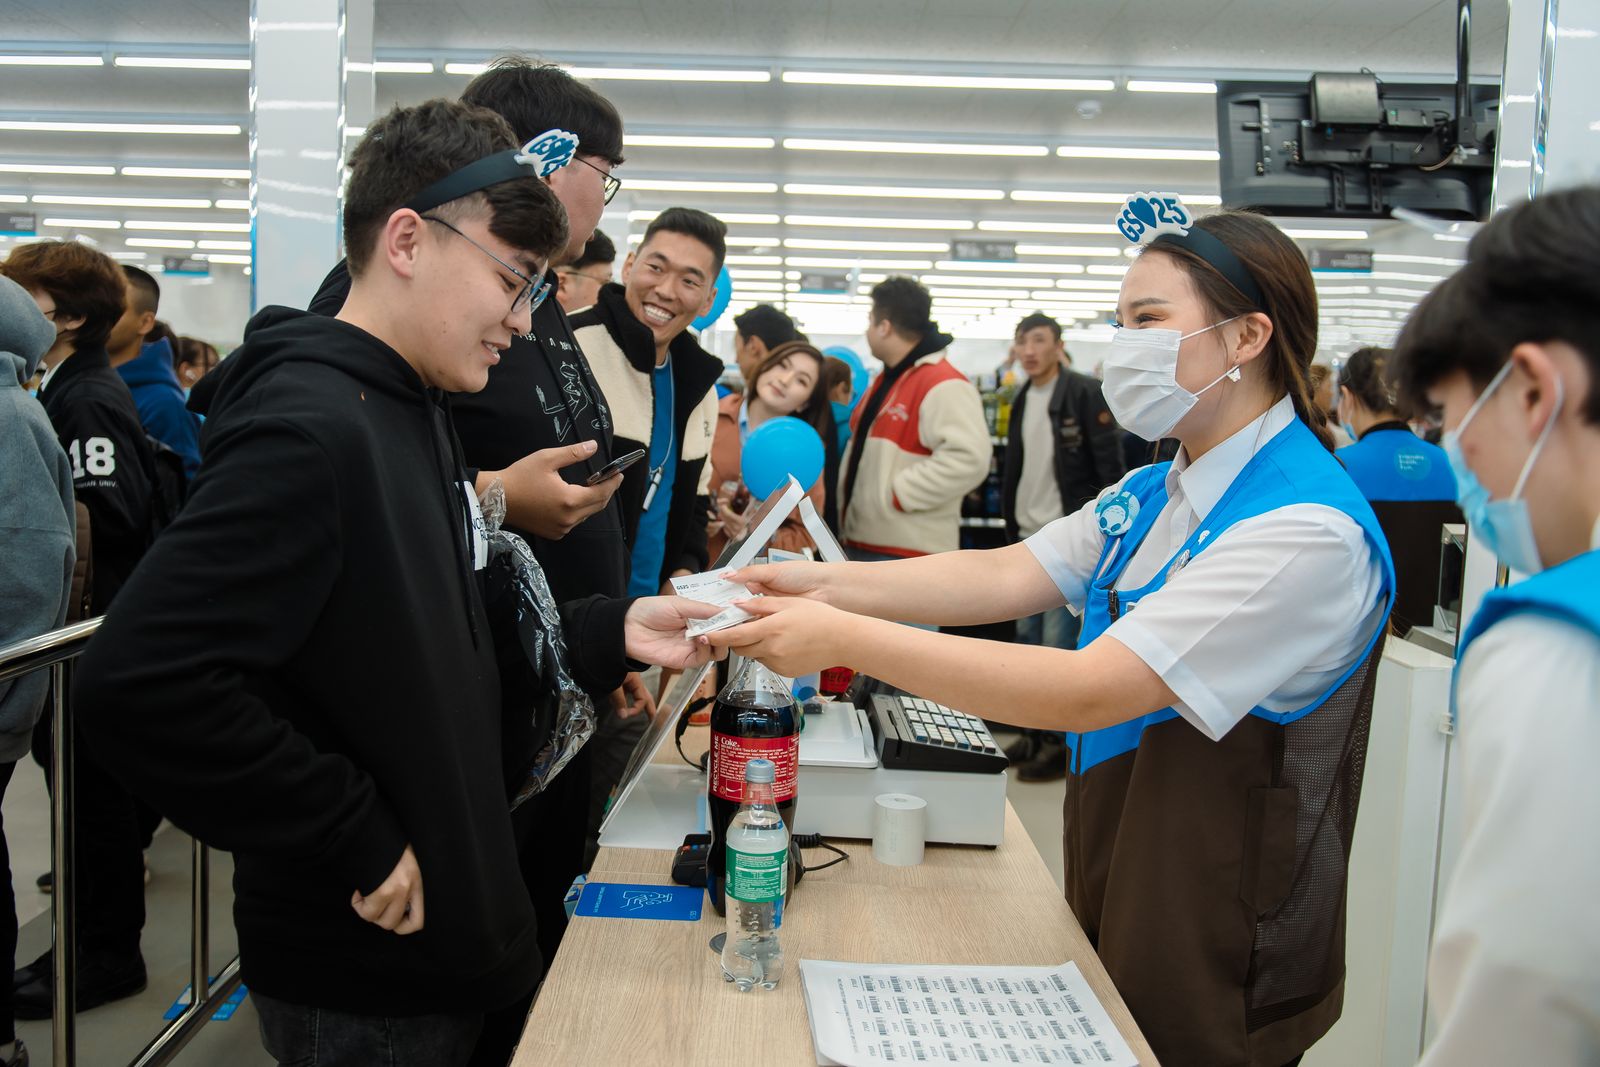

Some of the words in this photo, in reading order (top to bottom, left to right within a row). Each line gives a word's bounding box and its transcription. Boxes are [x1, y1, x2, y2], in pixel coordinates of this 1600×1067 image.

[1117, 209, 1145, 242] GS
[1149, 197, 1187, 225] 25
[69, 436, 115, 479] 18
[714, 735, 719, 749] ME
